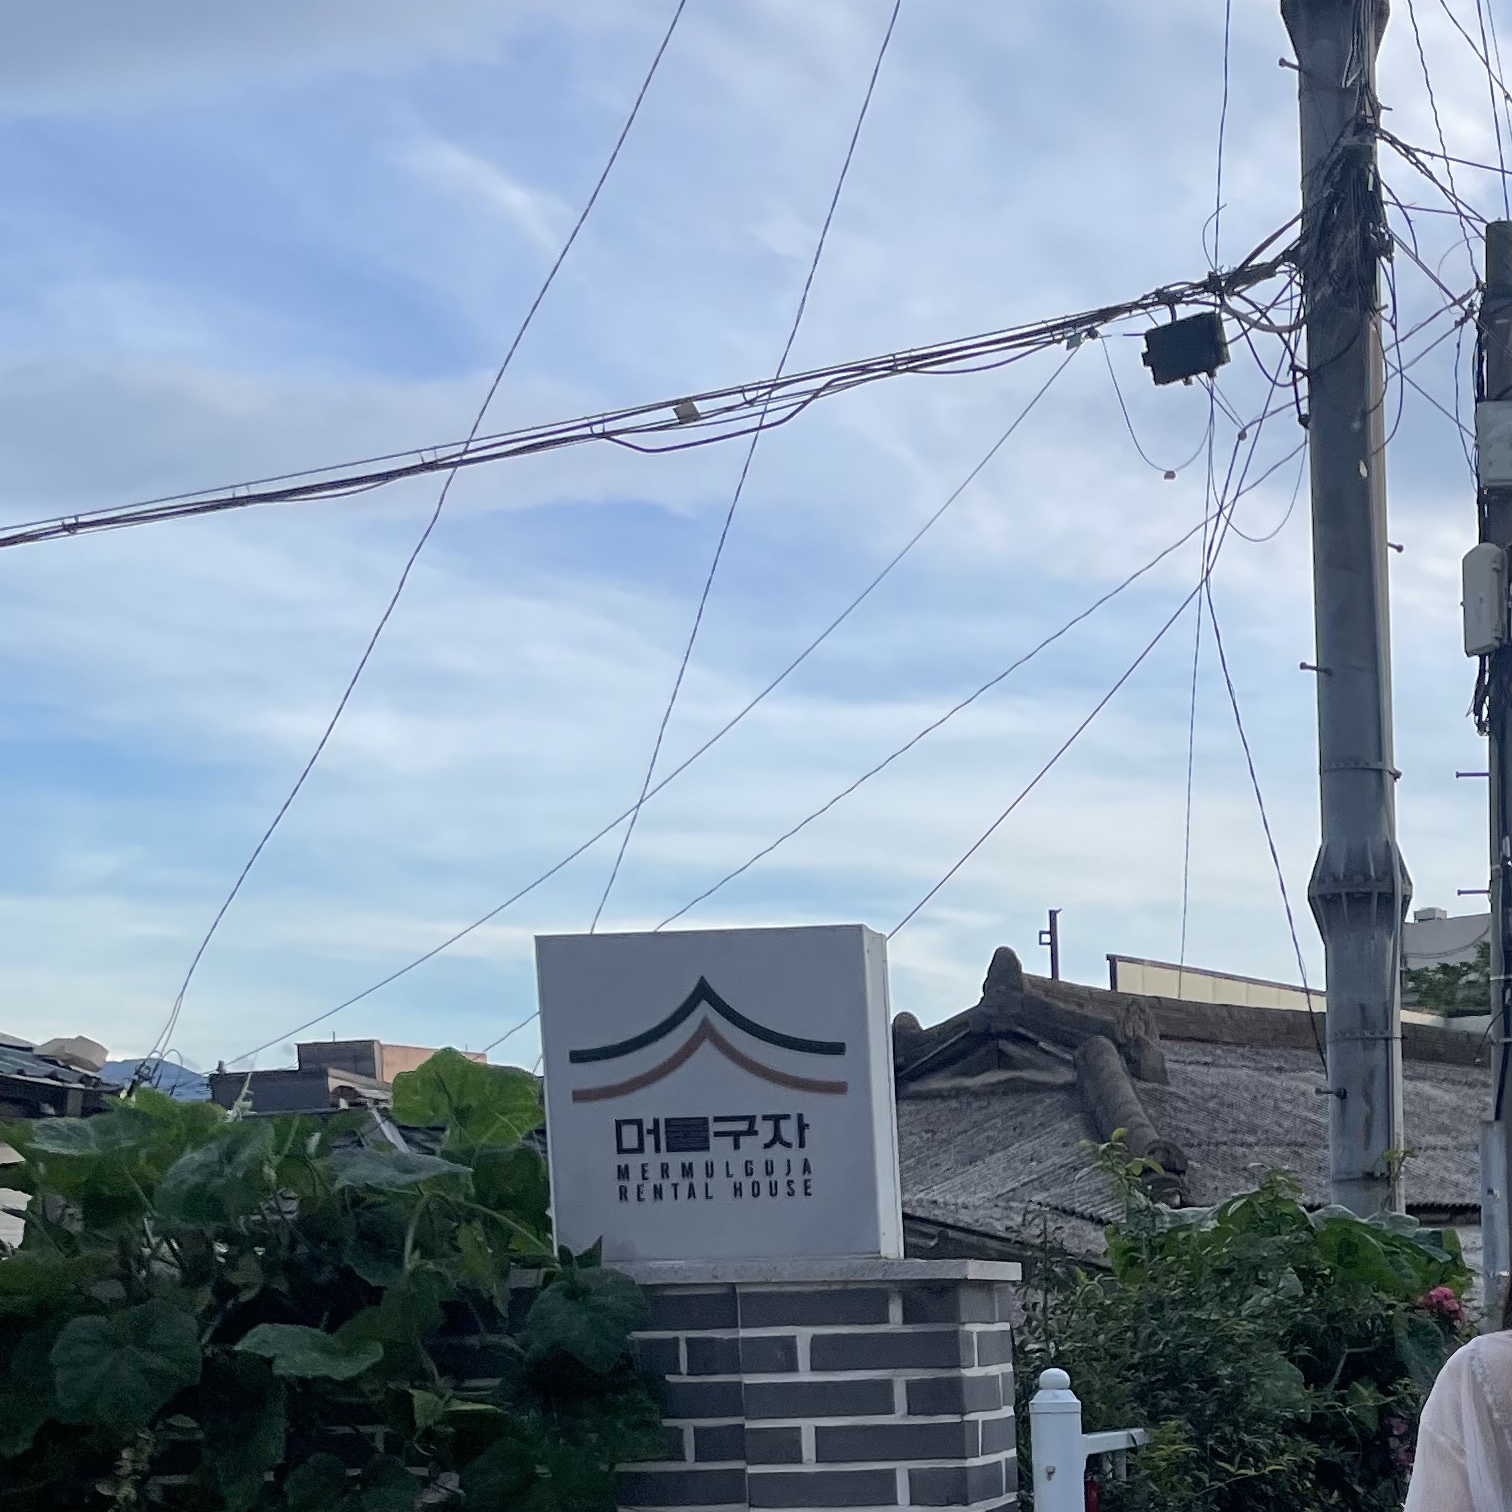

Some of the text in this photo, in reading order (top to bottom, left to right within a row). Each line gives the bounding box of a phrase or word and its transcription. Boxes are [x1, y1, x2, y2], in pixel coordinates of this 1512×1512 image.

[617, 1157, 812, 1181] MERMULGUJA
[618, 1178, 812, 1202] RENTAL HOUSE
